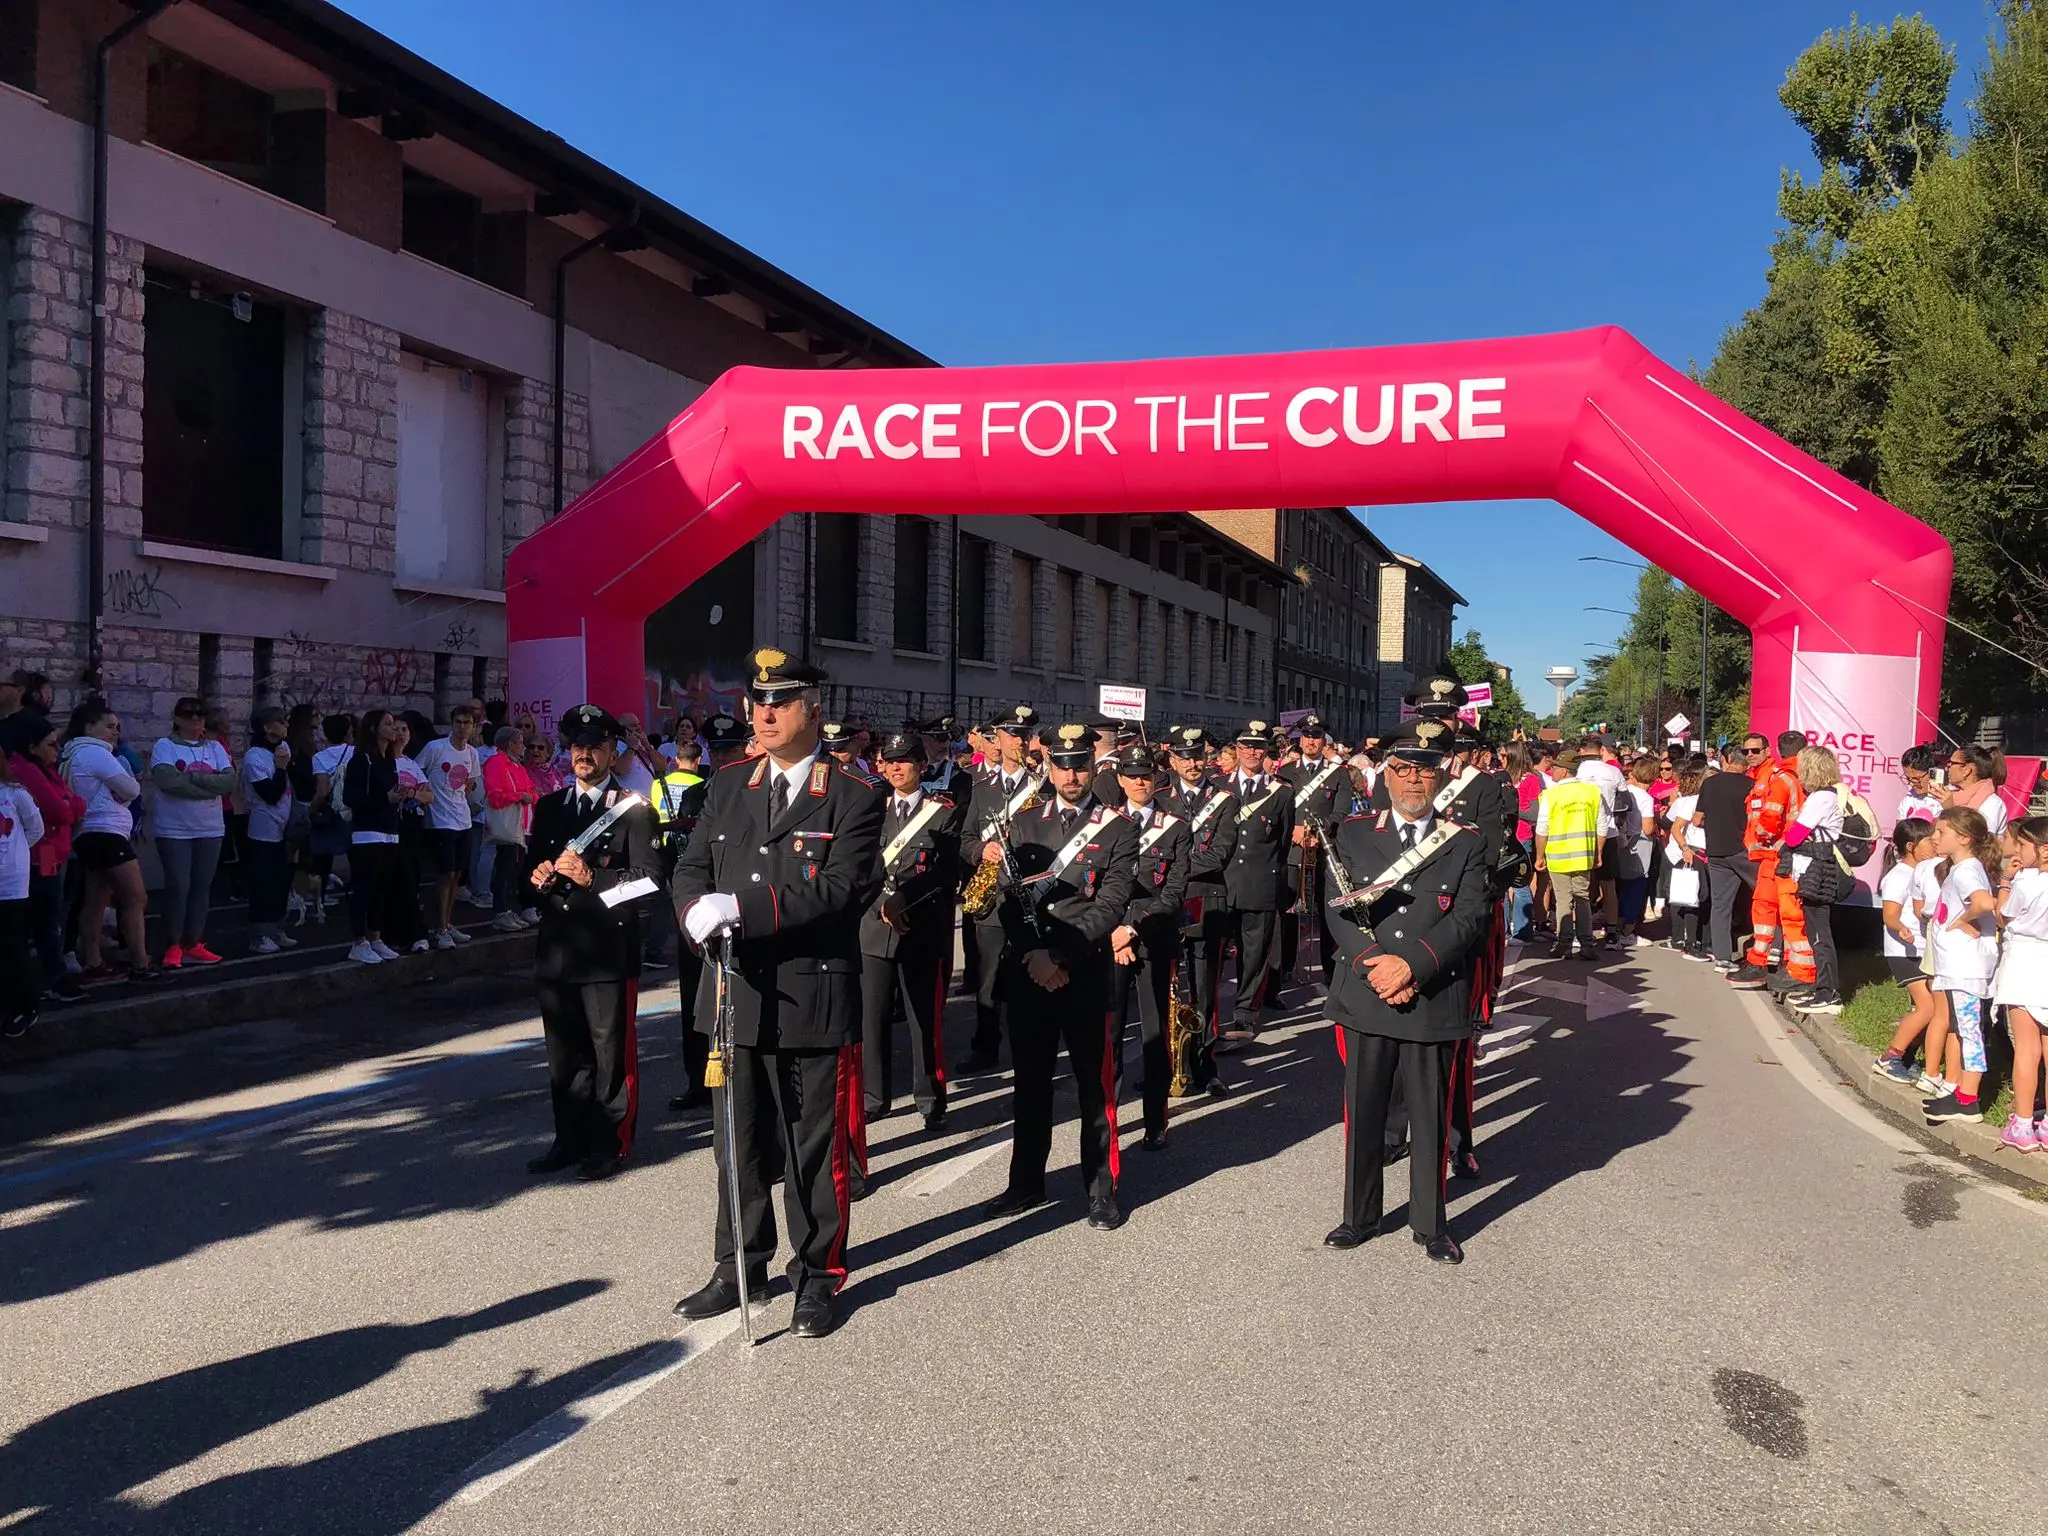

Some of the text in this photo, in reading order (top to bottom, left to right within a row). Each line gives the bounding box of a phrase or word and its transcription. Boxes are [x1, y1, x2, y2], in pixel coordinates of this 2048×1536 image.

[782, 377, 1507, 461] RACE FOR THE CURE
[513, 699, 552, 716] RACE
[1806, 730, 1874, 751] RACE
[1858, 754, 1900, 775] THE
[1841, 775, 1872, 796] RE
